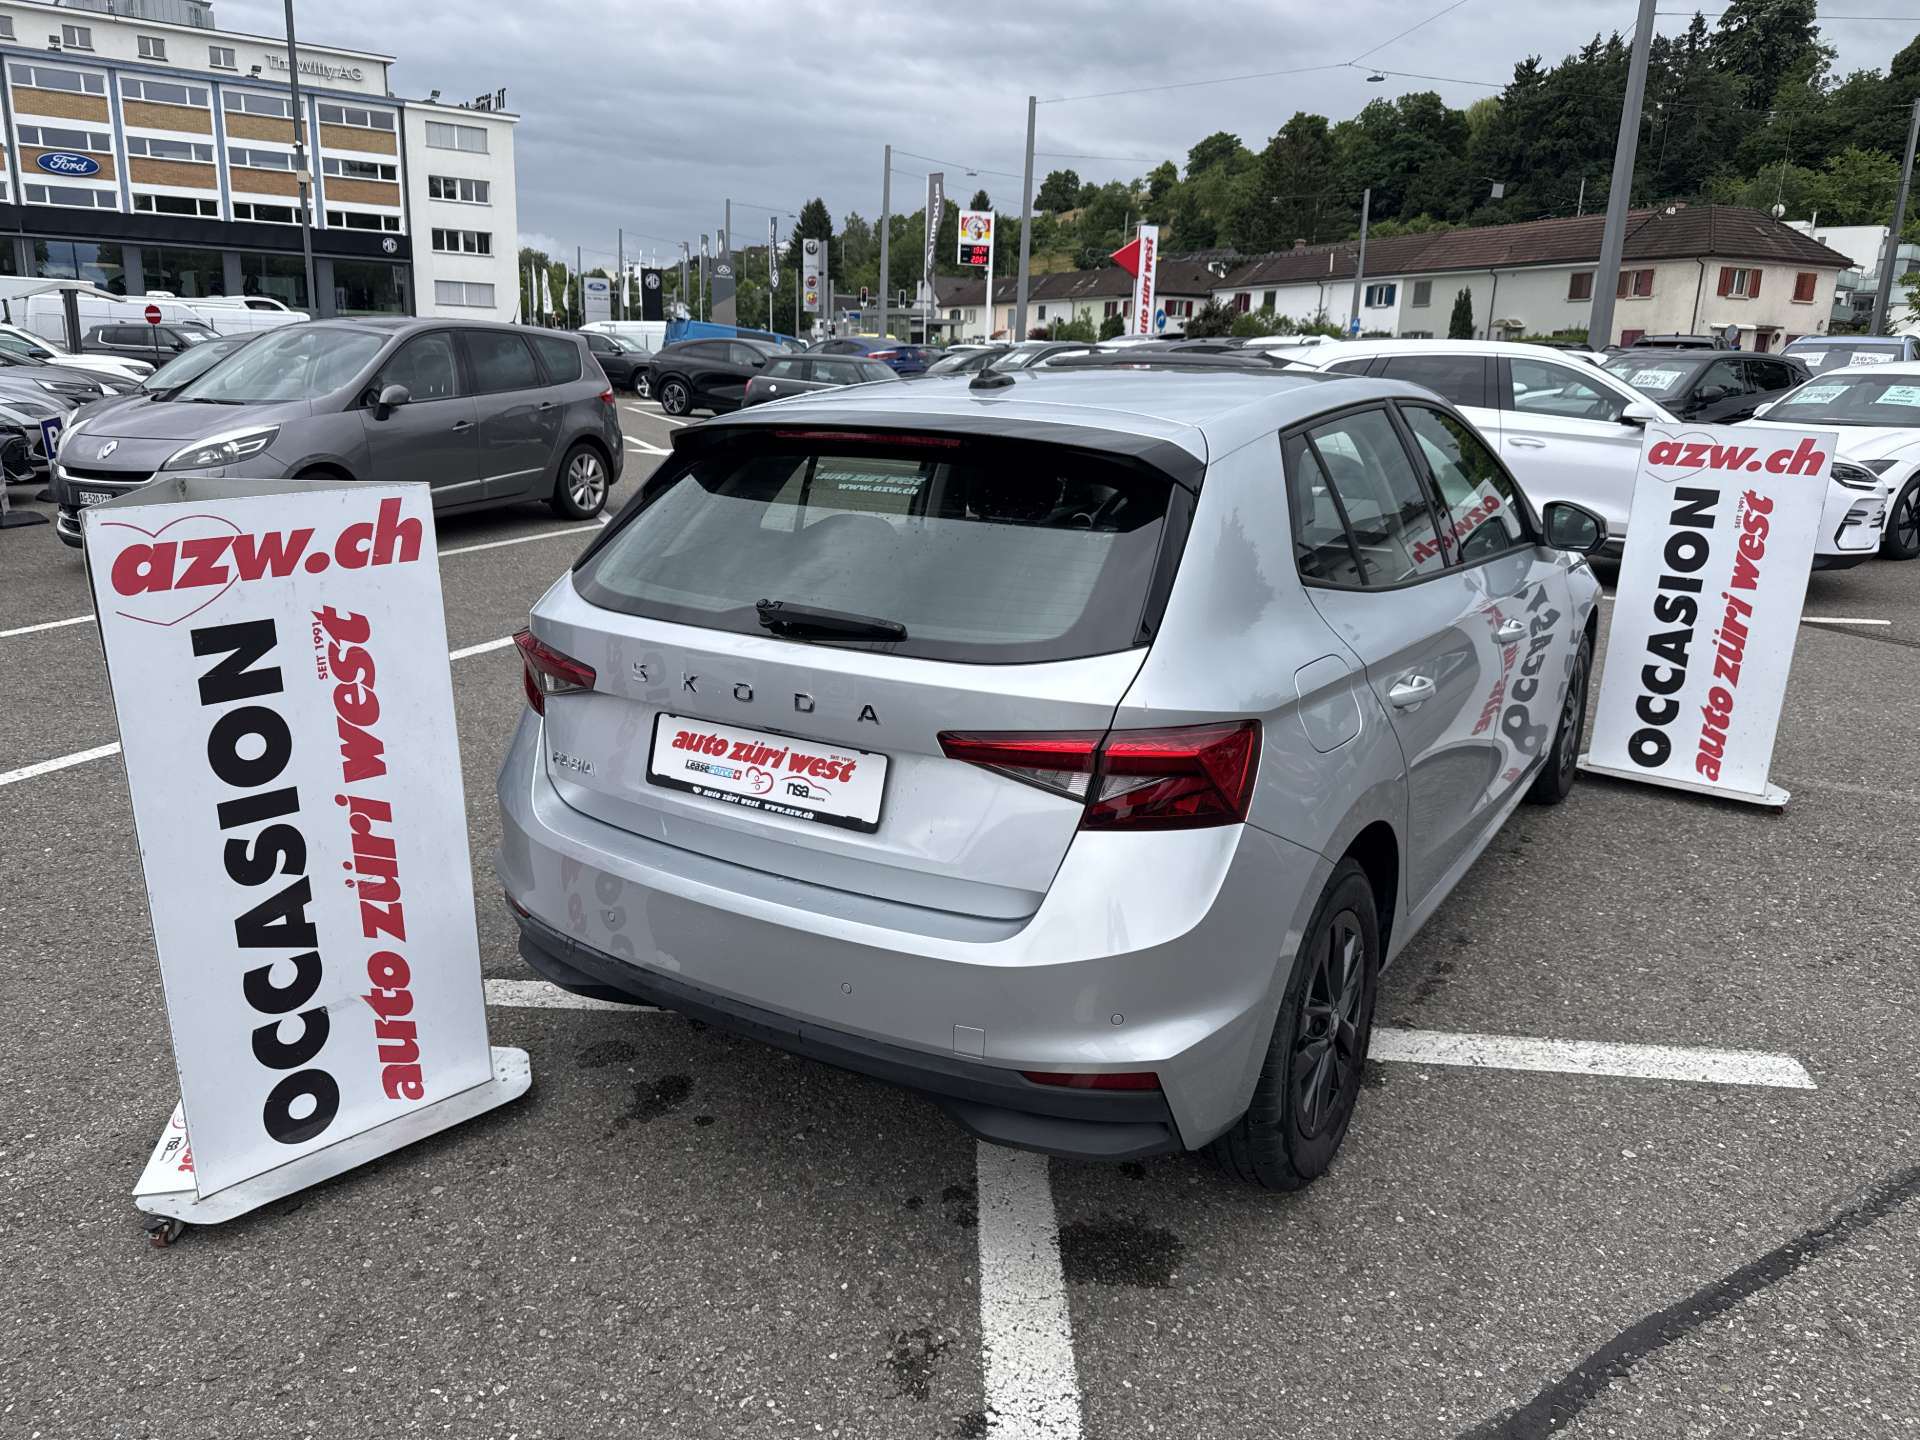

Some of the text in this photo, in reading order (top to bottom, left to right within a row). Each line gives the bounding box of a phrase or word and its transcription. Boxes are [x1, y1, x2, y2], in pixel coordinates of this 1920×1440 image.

[339, 65, 363, 81] AG
[50, 155, 87, 171] Ford
[383, 238, 397, 253] MG
[645, 273, 660, 289] MG
[1140, 309, 1149, 334] uto
[47, 426, 60, 453] P
[1647, 438, 1826, 477] azw.ch
[111, 497, 424, 597] azw.ch
[1627, 486, 1721, 768] OCCASION
[1695, 489, 1774, 782] auto züri west
[311, 620, 329, 681] SEIT 1991
[552, 750, 596, 777] FABIA
[672, 730, 857, 783] auto züri west
[703, 789, 721, 799] auto
[741, 798, 760, 808] west
[764, 802, 815, 819] www.azw.ch
[786, 782, 810, 798] nsa
[311, 604, 425, 1101] auto züri west
[190, 618, 341, 1145] OCCASION
